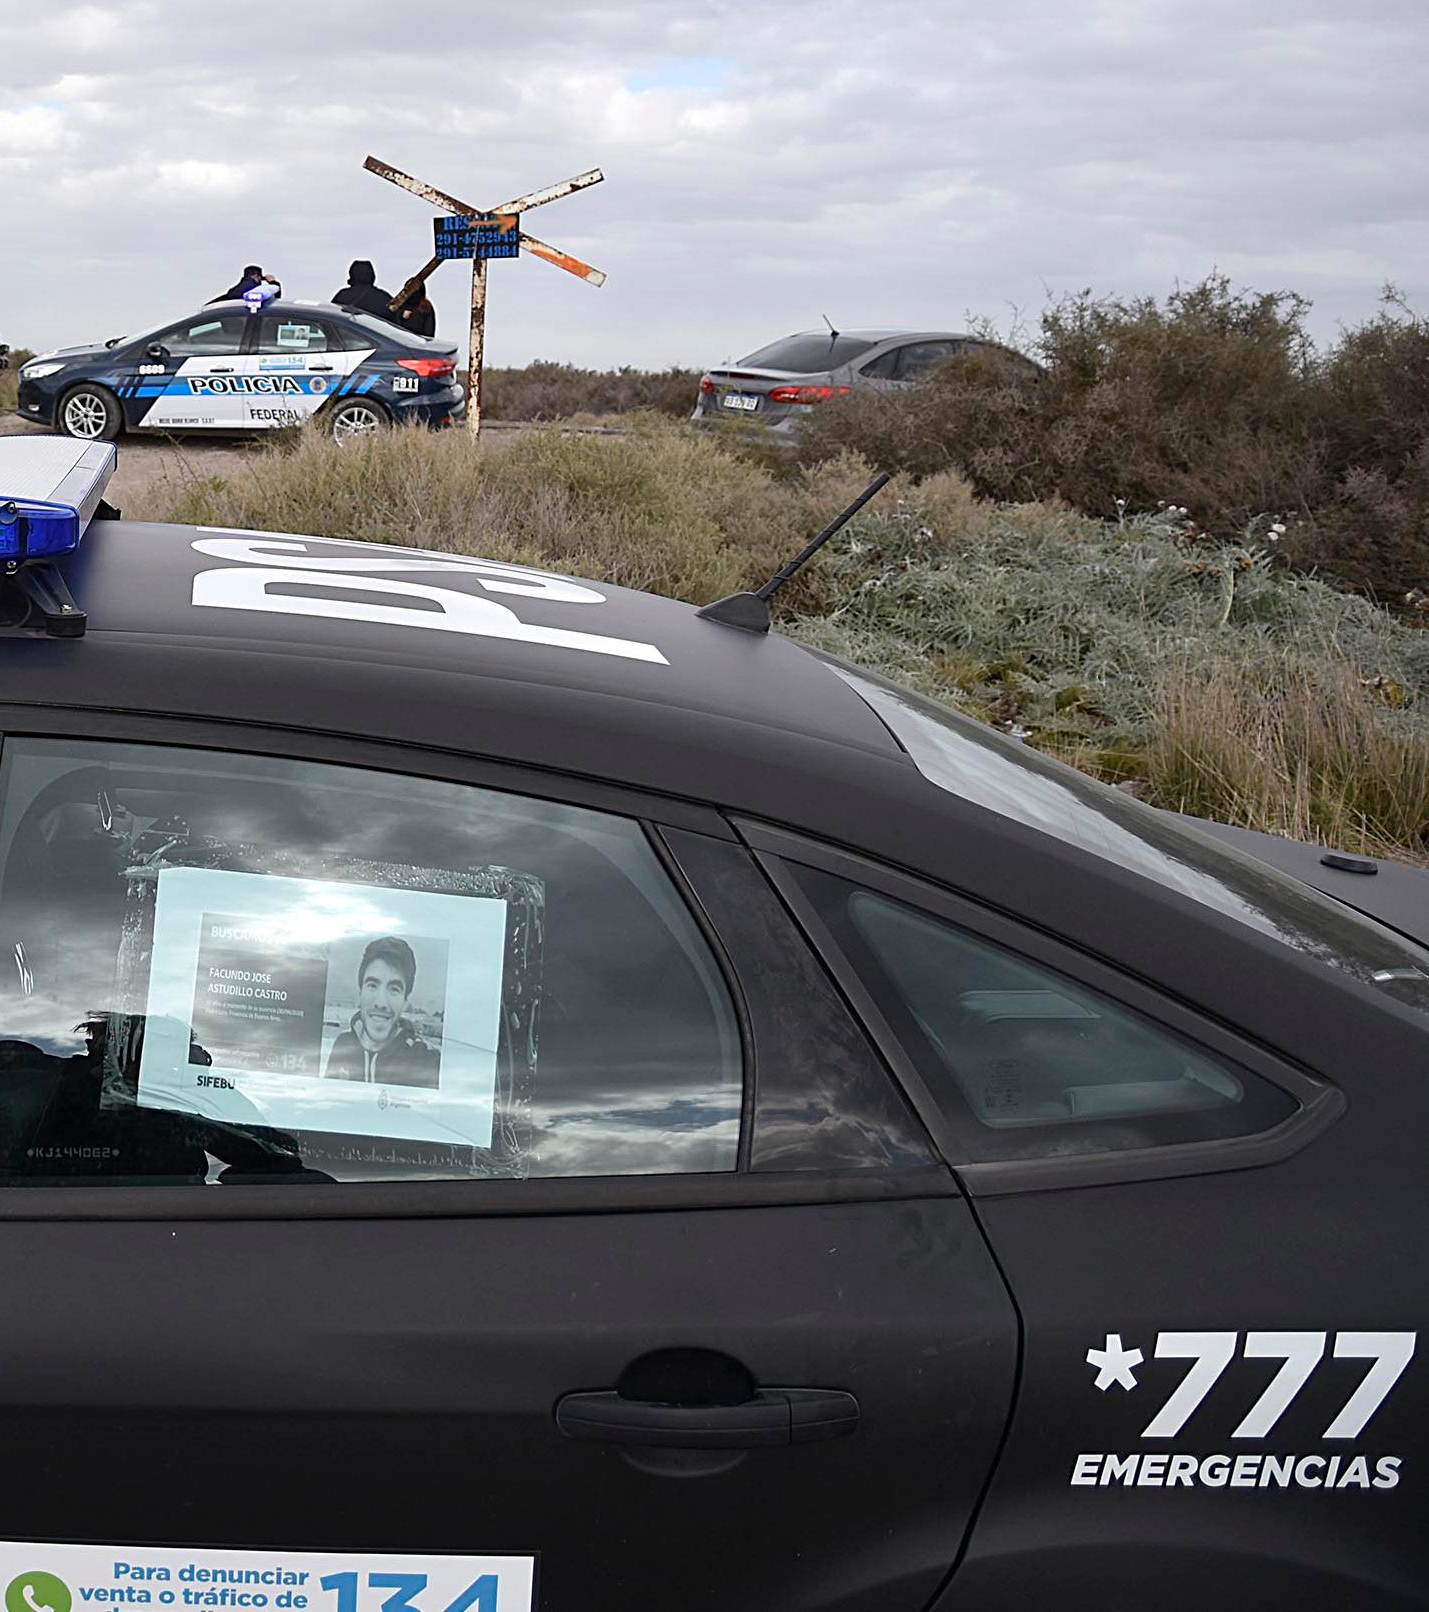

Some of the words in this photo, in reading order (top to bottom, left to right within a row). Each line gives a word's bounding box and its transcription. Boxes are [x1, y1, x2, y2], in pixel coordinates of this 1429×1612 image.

[188, 376, 303, 394] POLICIA
[209, 967, 250, 982] FACUNDO
[207, 983, 253, 998] ASTUDILLO
[254, 988, 287, 1001] CASTRO
[281, 1054, 307, 1071] 134
[1070, 1453, 1403, 1489] EMERGENCIAS
[113, 1562, 171, 1581] Para
[178, 1564, 309, 1586] denunciar
[79, 1586, 152, 1603] venta
[158, 1591, 176, 1604] o
[182, 1586, 268, 1607] tráfico
[275, 1590, 308, 1609] de
[320, 1572, 499, 1612] 134
